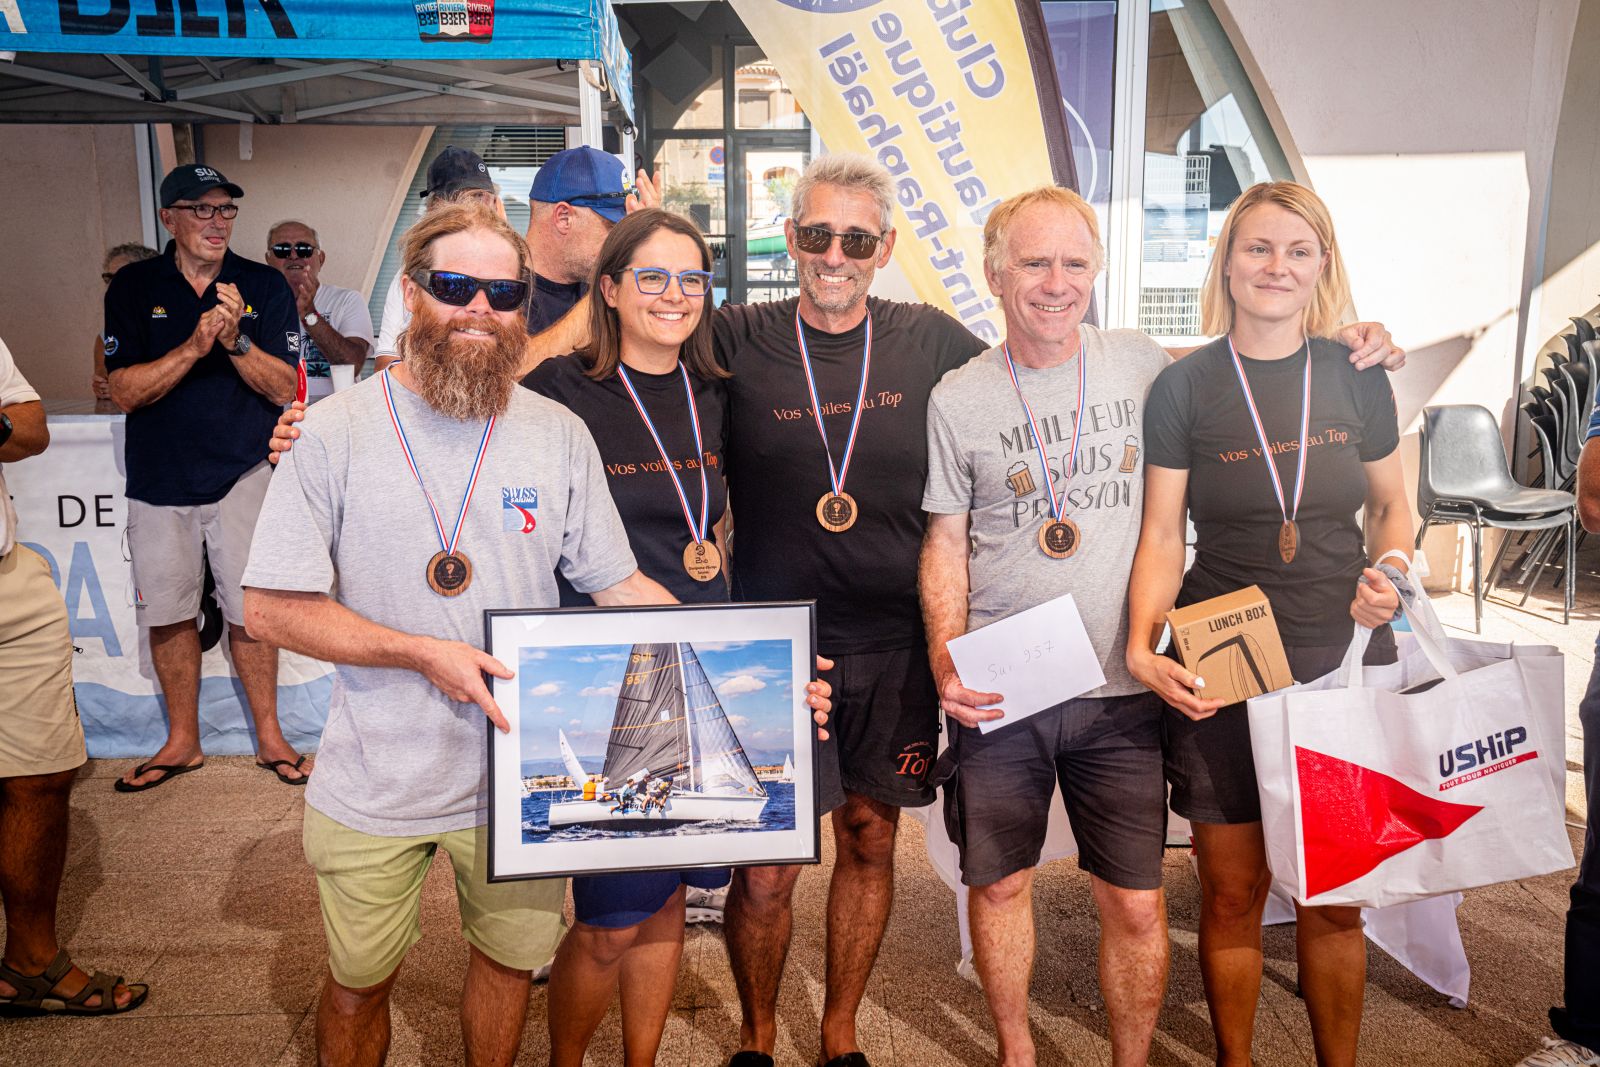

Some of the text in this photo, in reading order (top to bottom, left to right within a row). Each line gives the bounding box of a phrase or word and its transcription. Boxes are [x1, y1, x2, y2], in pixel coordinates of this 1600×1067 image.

[439, 3, 467, 12] RIVIERA
[440, 12, 467, 26] BEER
[773, 408, 802, 421] Vos
[877, 391, 903, 408] Top
[999, 398, 1137, 458] MEILLEUR
[1219, 450, 1249, 463] Vos
[1306, 434, 1324, 447] au
[1325, 428, 1348, 444] Top
[607, 451, 718, 476] Vos voils au Top
[1047, 443, 1113, 484] SOUS
[502, 487, 537, 498] SWISS
[57, 494, 116, 528] DE
[1208, 604, 1268, 633] LUNCH BOX
[895, 752, 930, 780] To
[1441, 758, 1517, 790] TOUT POUR NAVIGUER
